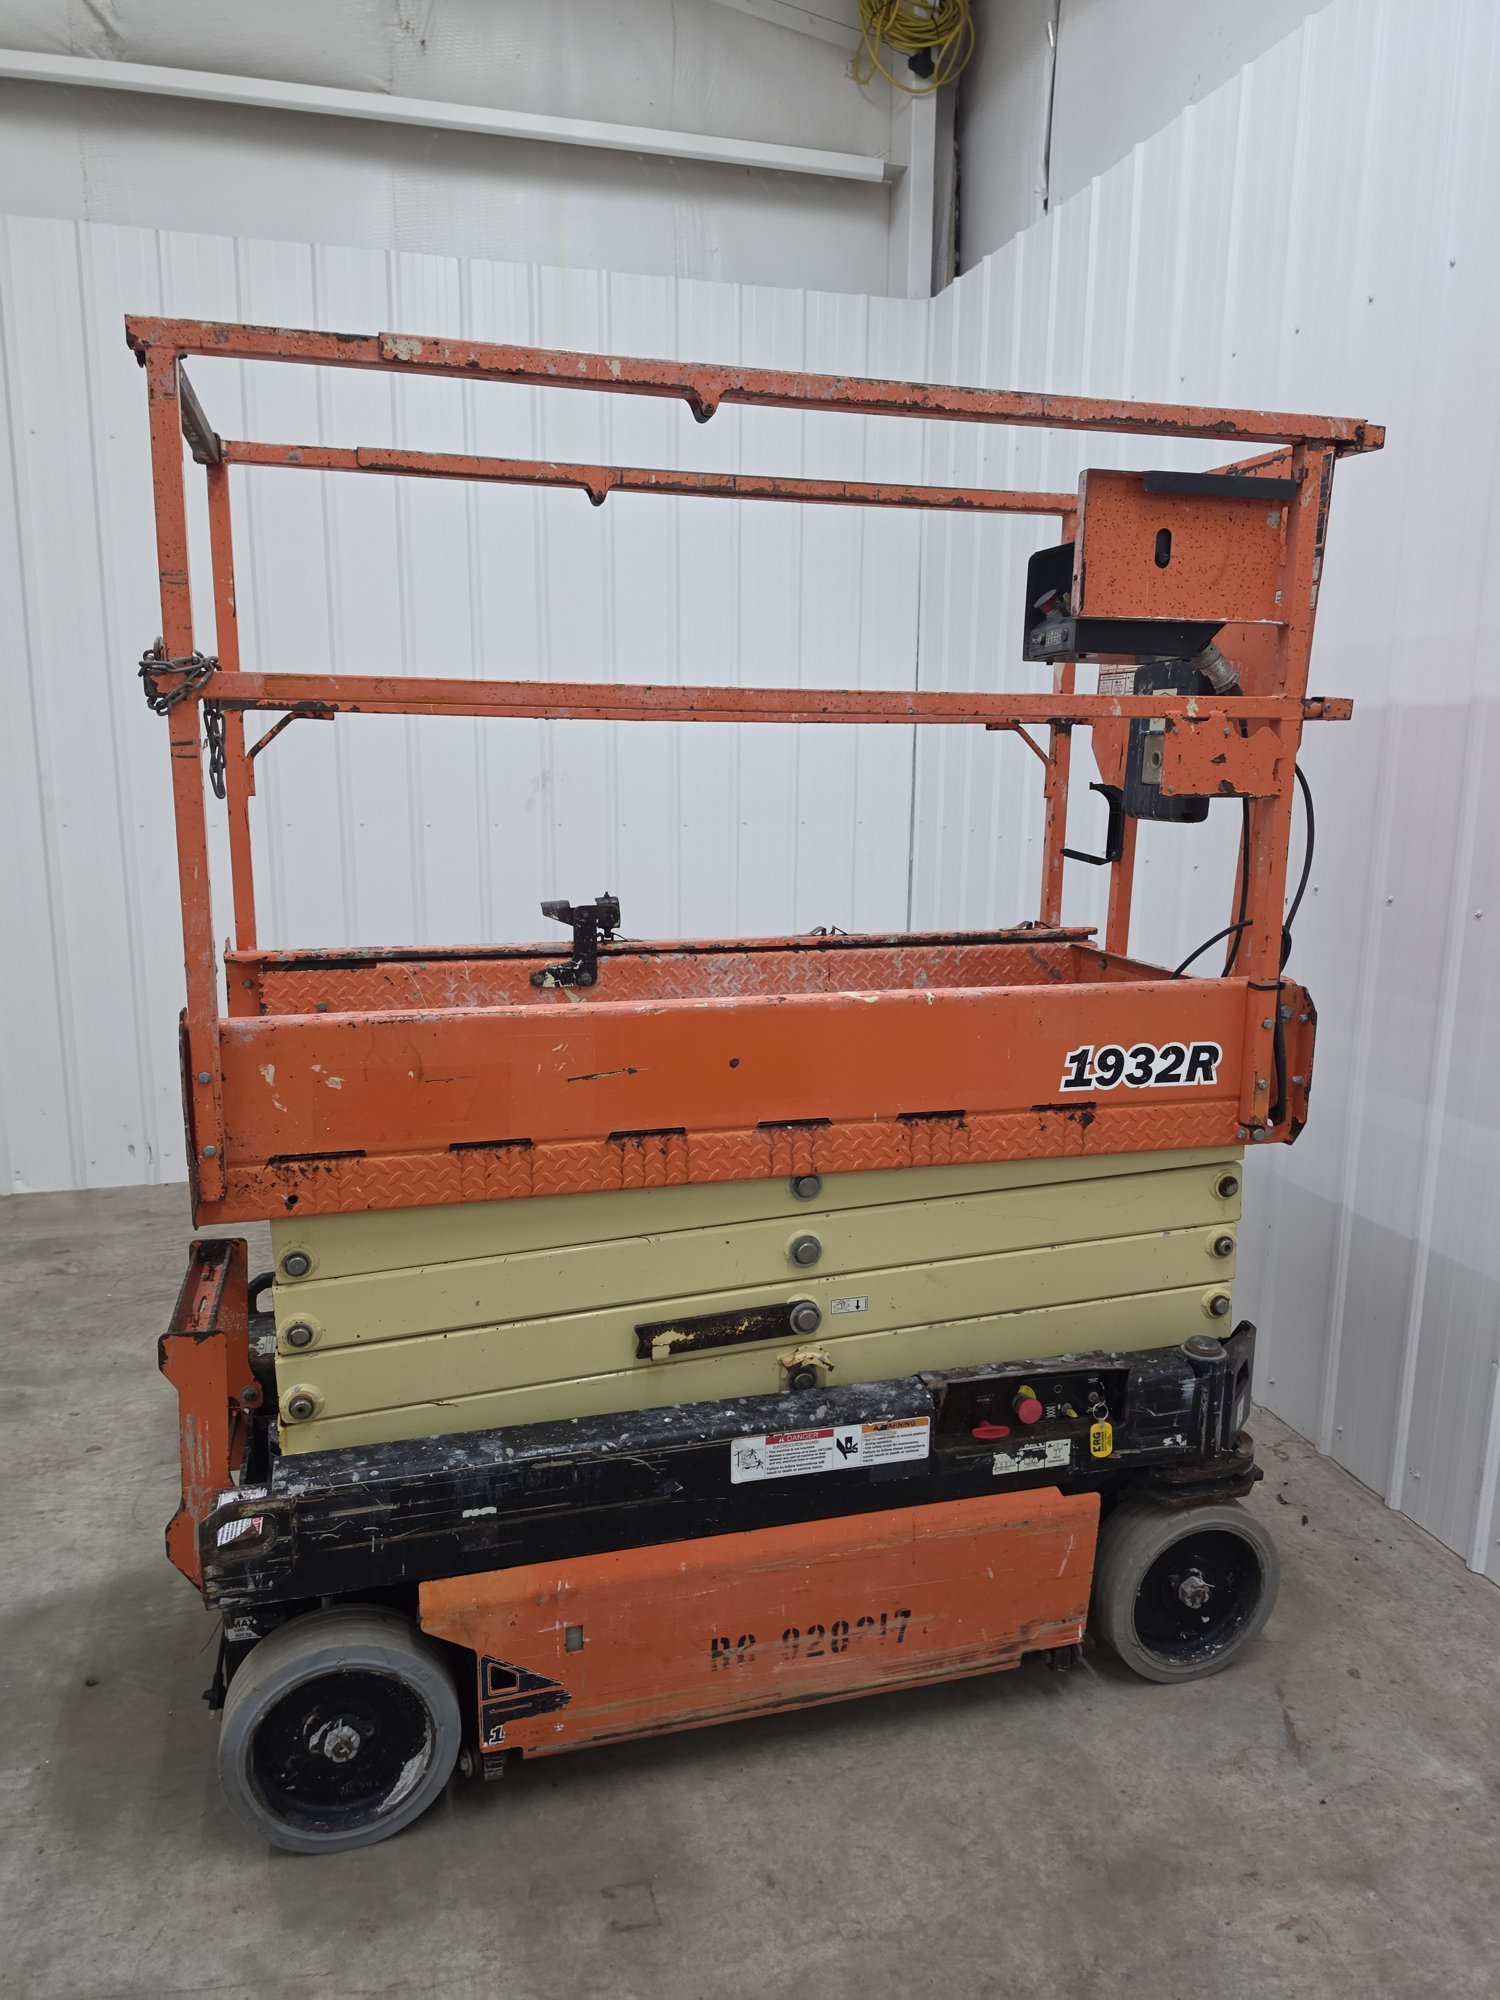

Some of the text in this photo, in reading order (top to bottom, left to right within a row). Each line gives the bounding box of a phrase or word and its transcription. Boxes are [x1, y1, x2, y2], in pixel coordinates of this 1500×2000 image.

[1060, 1042, 1222, 1091] 1932R
[879, 1421, 915, 1430] ARNING
[786, 1432, 819, 1442] DANGER
